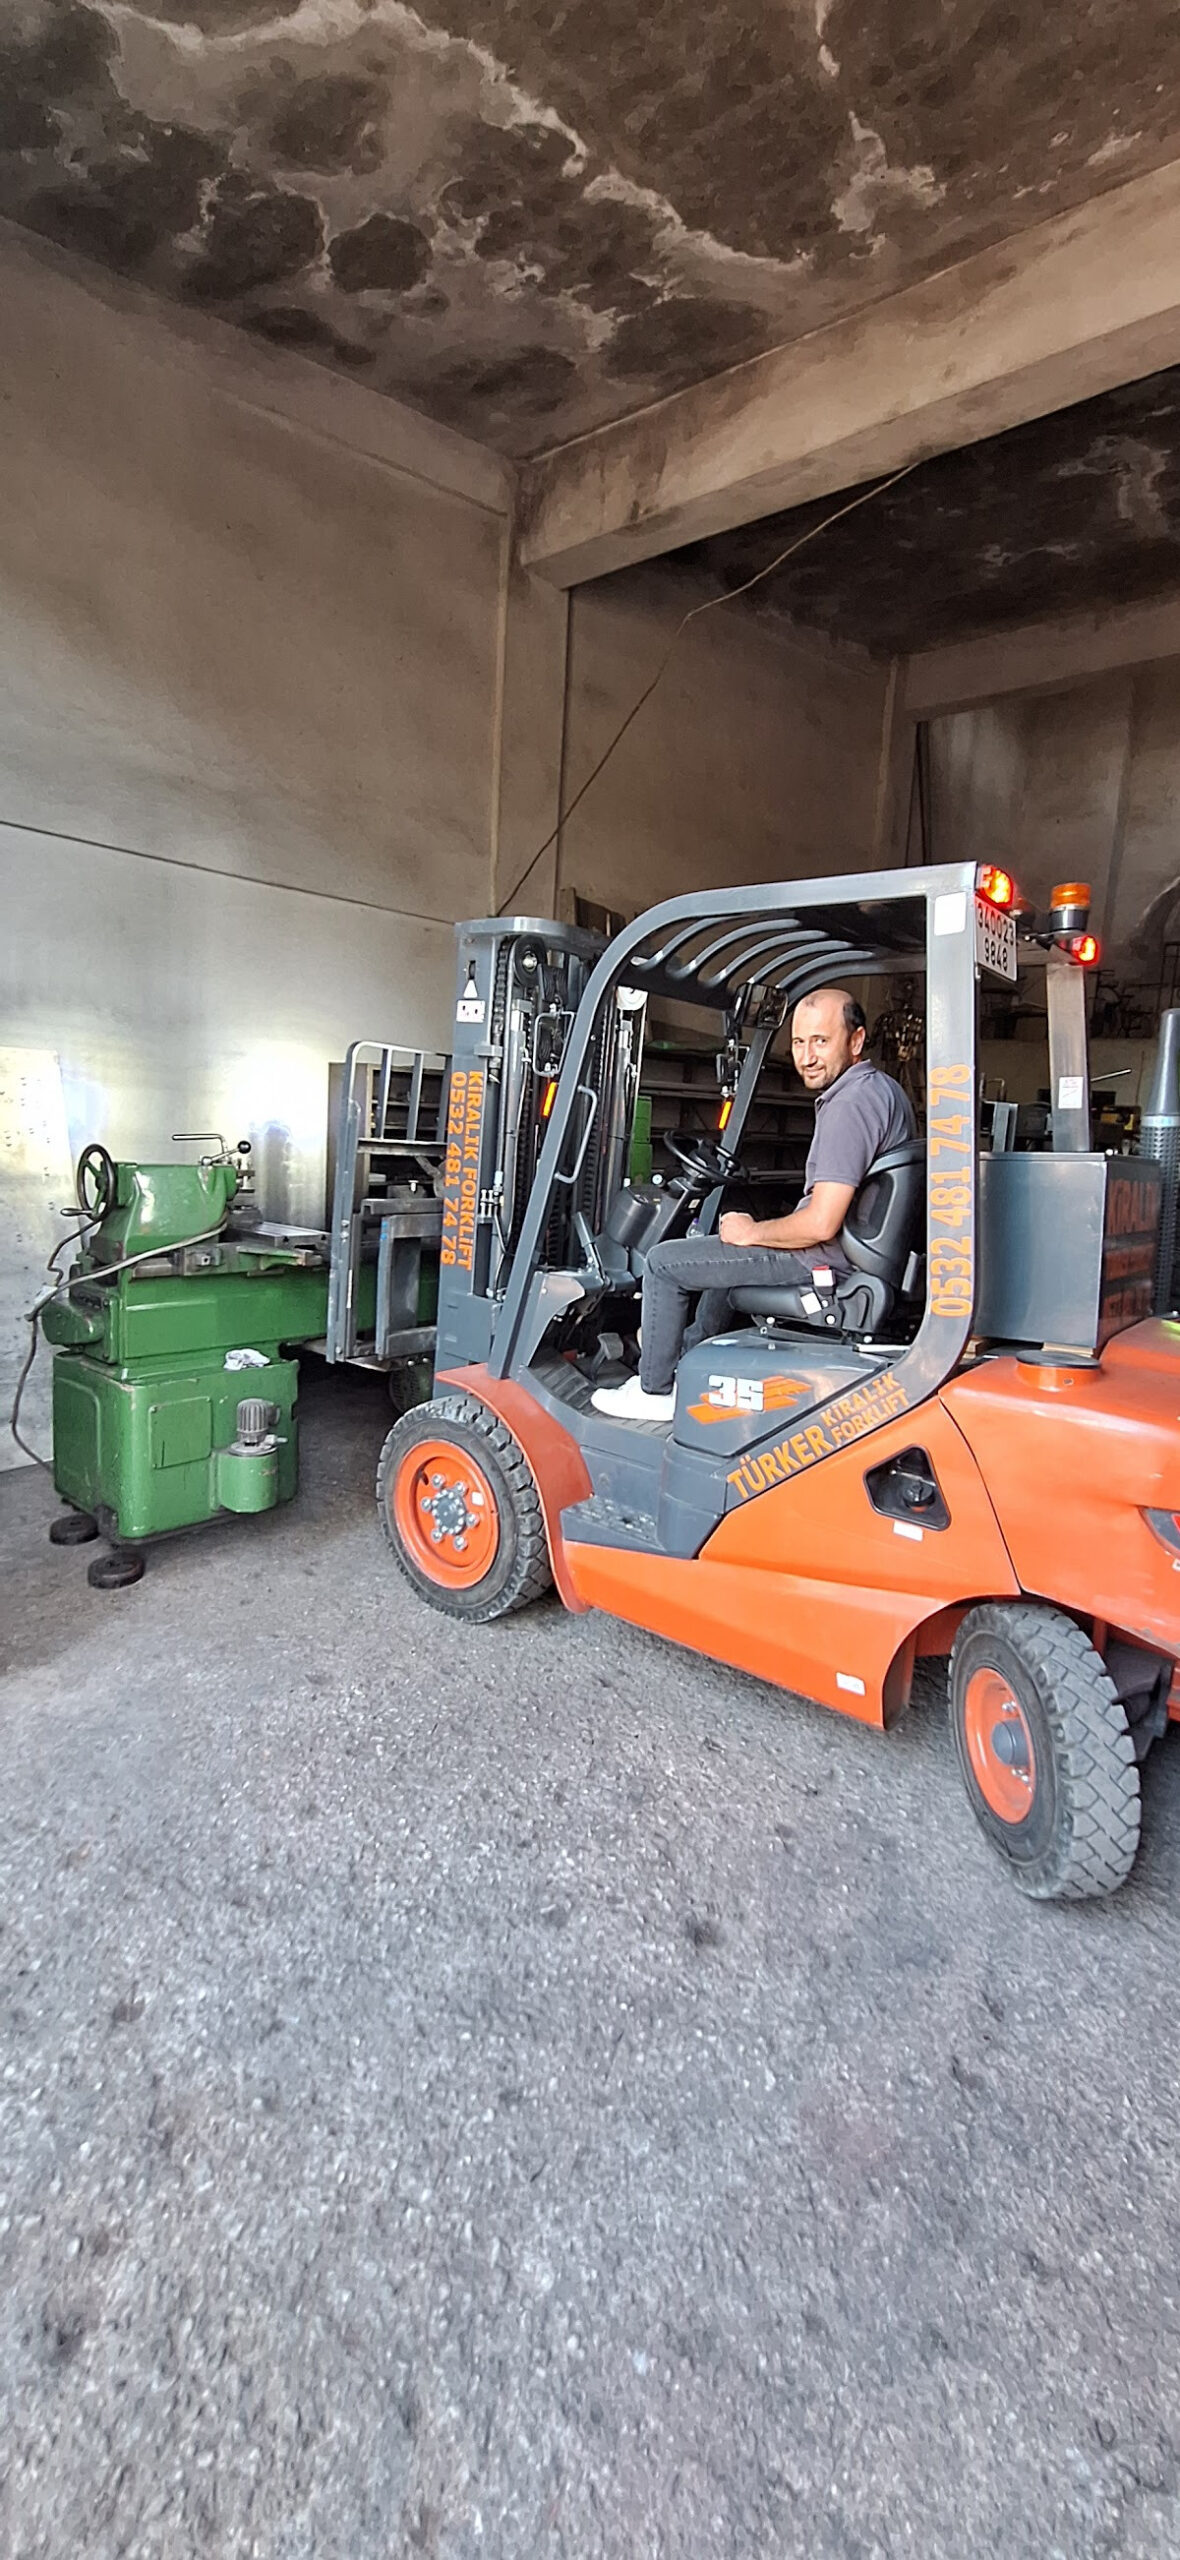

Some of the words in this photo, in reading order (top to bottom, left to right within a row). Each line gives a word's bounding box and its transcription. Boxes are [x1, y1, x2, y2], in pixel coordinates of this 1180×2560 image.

[985, 937, 1008, 972] 9848
[449, 1071, 468, 1135] 0532
[929, 1063, 971, 1107] 78
[930, 1114, 971, 1157] 74
[445, 1142, 463, 1187] 481
[443, 1197, 459, 1226] 74
[930, 1166, 972, 1228] 481
[440, 1235, 457, 1266] 78
[930, 1235, 973, 1318] 0532
[708, 1374, 764, 1412] 35
[726, 1424, 834, 1499] TÜRKER
